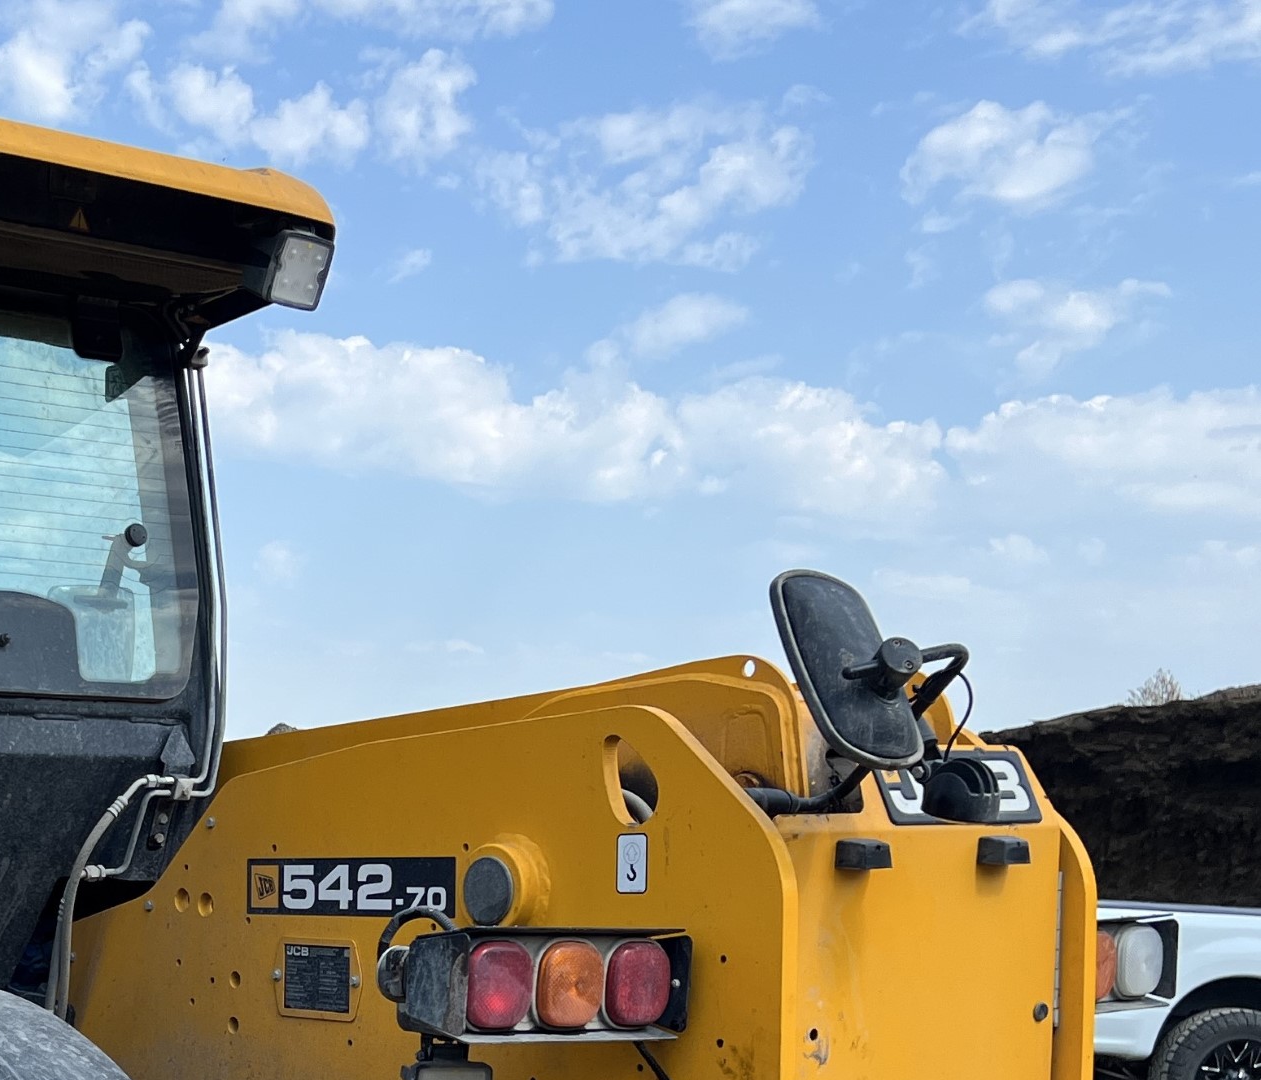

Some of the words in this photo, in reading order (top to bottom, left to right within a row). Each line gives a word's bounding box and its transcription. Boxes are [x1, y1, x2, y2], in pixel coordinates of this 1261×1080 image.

[881, 760, 1030, 815] JB
[257, 876, 276, 899] JCB
[286, 945, 309, 957] JCB
